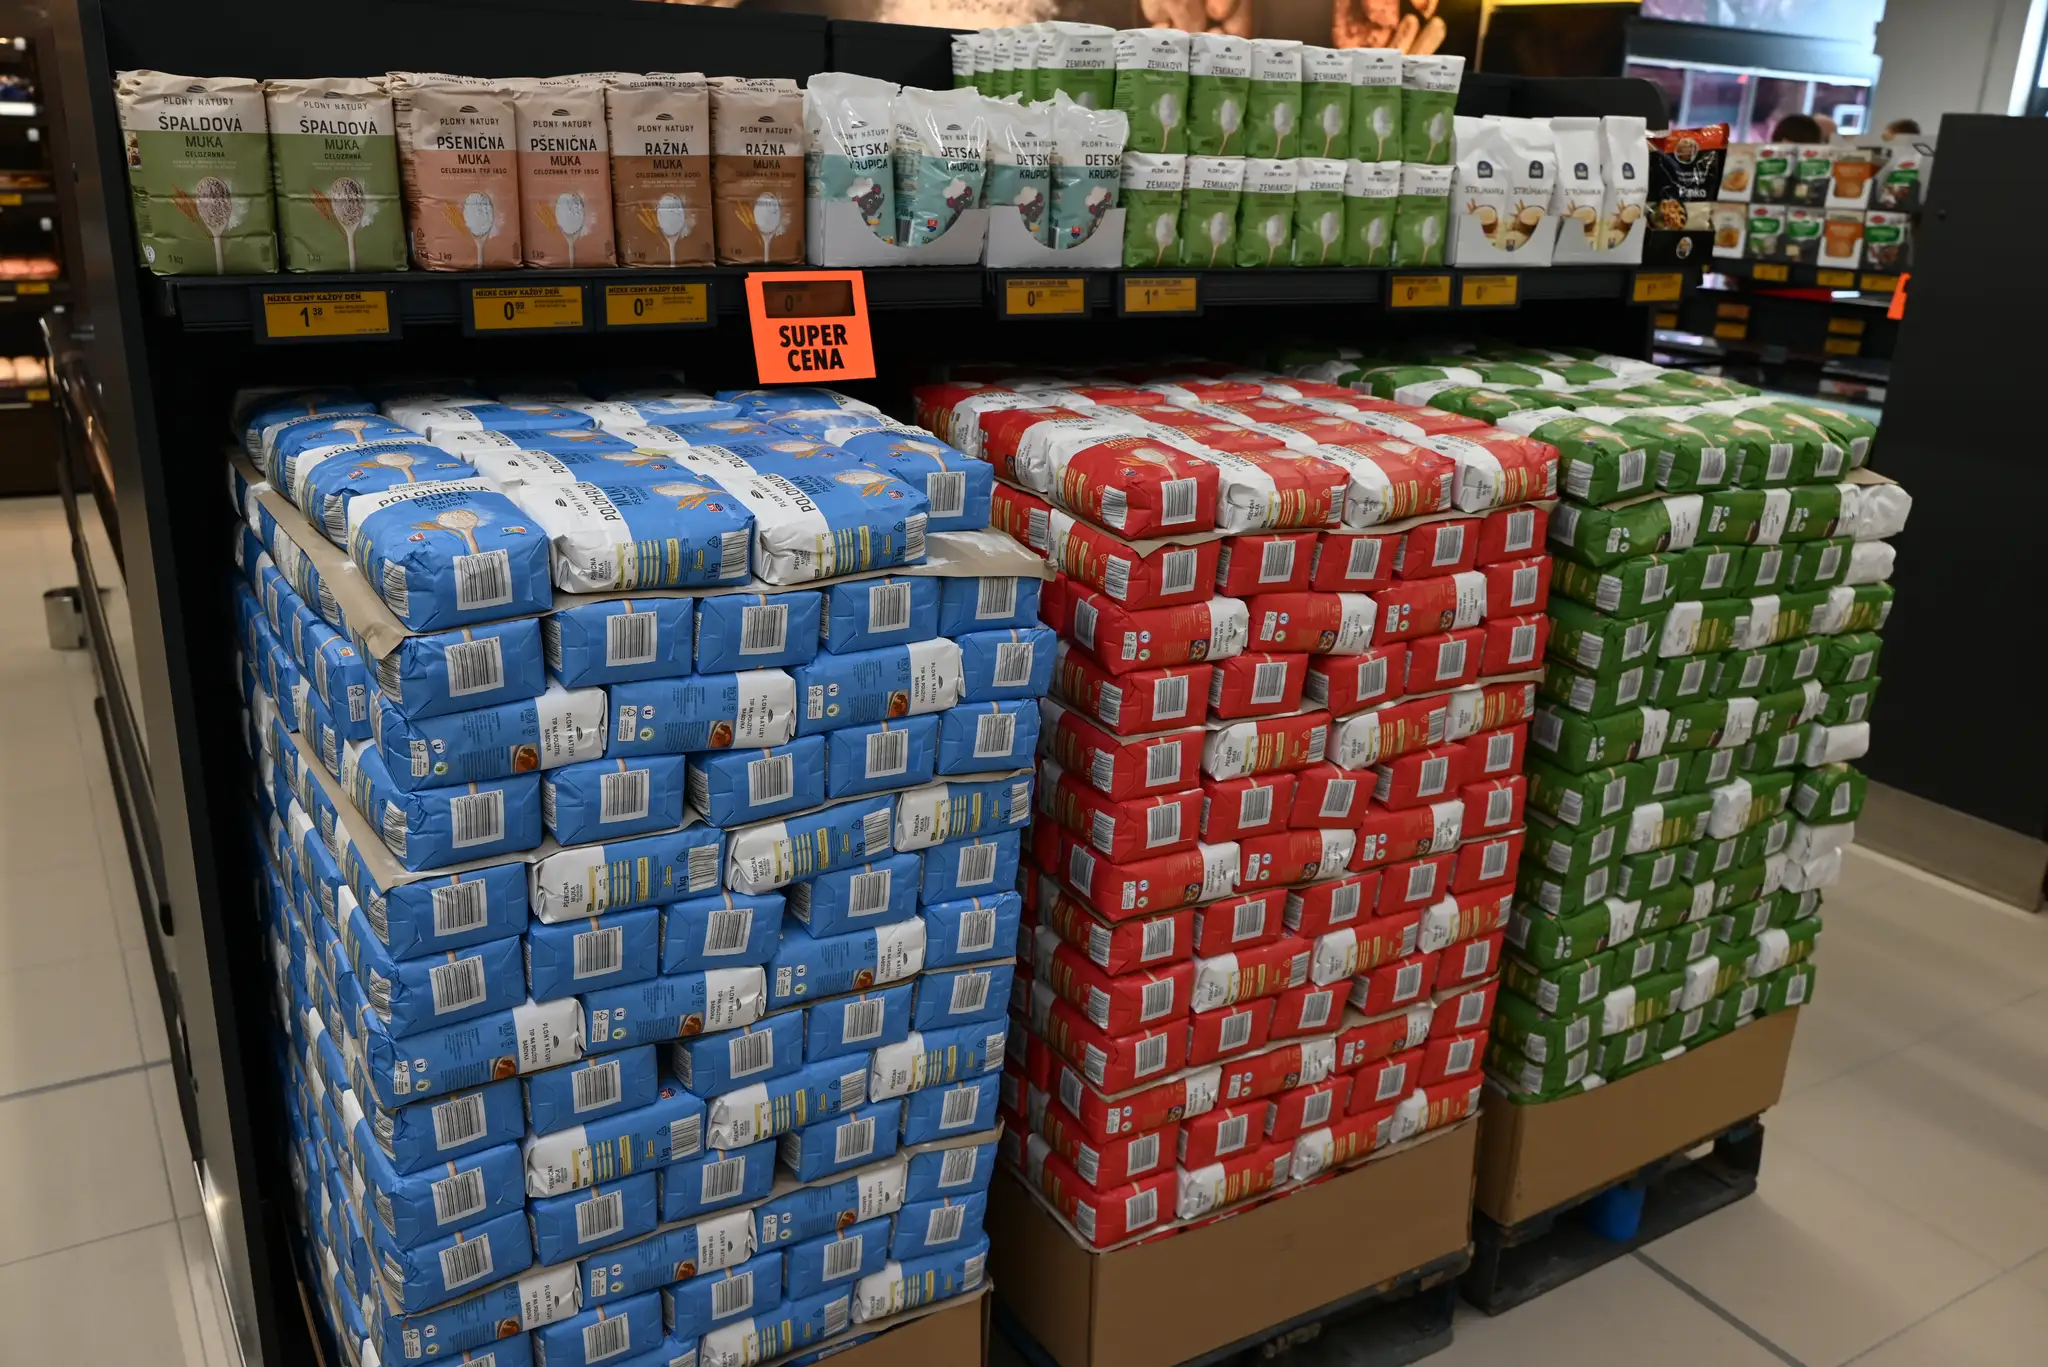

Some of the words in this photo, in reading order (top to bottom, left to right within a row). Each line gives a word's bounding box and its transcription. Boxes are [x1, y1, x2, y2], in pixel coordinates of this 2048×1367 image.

[163, 96, 193, 106] PLONY
[198, 97, 234, 106] NATURY
[304, 101, 331, 110] PLONY
[335, 102, 368, 111] NATURY
[440, 117, 466, 126] PLONY
[470, 118, 500, 126] NATURY
[533, 120, 558, 128] PLONY
[562, 120, 592, 128] NATURY
[637, 124, 661, 133] PLONY
[665, 124, 694, 133] NATURY
[766, 127, 793, 135] NATURY
[1016, 154, 1050, 166] DETSK
[1085, 154, 1121, 166] DETSK
[1020, 169, 1050, 180] KRUPIC
[1088, 169, 1120, 180] KRUPIC
[267, 294, 291, 302] NÍZKE
[1027, 290, 1036, 307] 0
[504, 301, 514, 320] 0
[634, 298, 644, 316] 0
[299, 307, 310, 327] 1
[312, 307, 323, 316] 38
[779, 324, 848, 347] SUPER
[788, 348, 845, 372] CENA
[760, 694, 768, 713] PLONY
